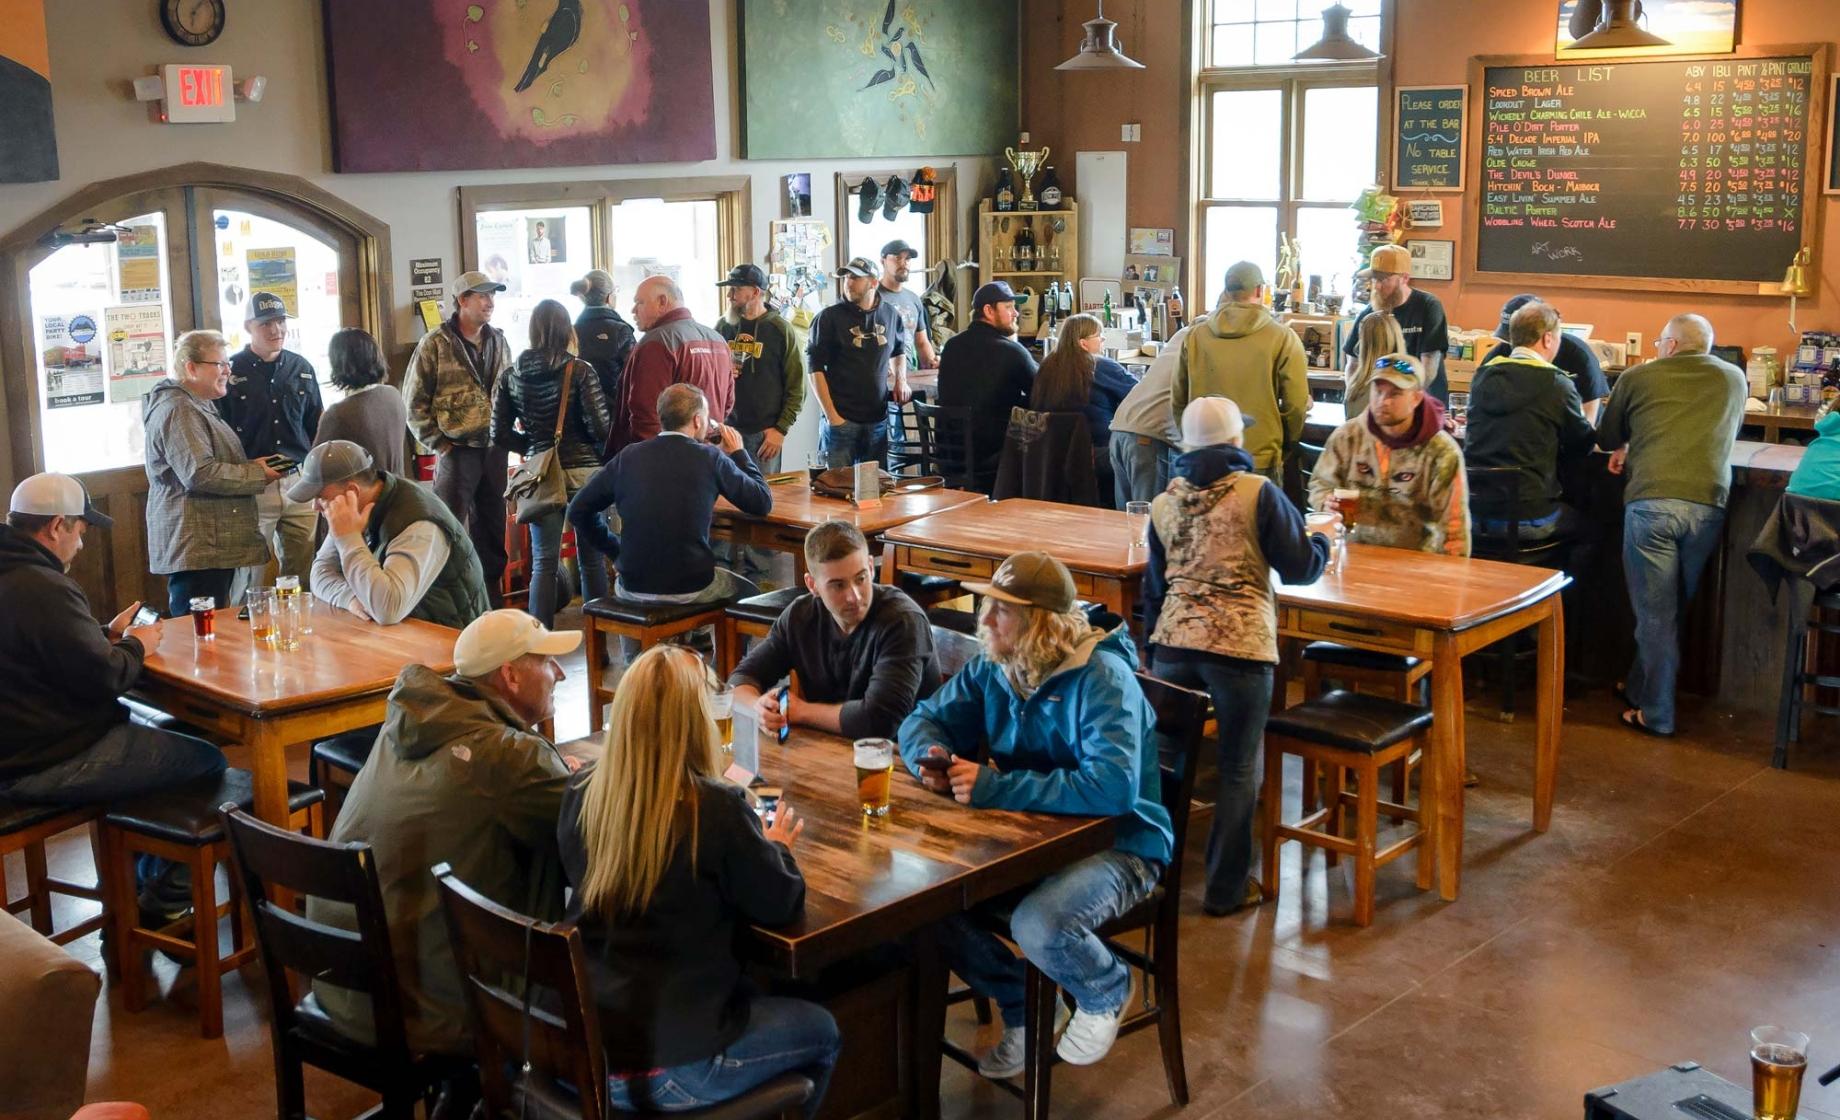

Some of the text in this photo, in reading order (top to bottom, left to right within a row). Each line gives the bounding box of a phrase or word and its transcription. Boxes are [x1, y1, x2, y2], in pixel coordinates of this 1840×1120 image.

[1525, 66, 1615, 83] BEER LIST
[1712, 64, 1731, 77] IBU
[179, 68, 223, 106] EXIT
[1489, 84, 1575, 98] SPICED BROWN ALE
[1713, 81, 1726, 91] 15
[1401, 94, 1433, 110] PLEASE
[1489, 98, 1562, 109] LOOKOUT LAGER
[1711, 94, 1724, 105] 22
[1711, 107, 1724, 117] 15
[1404, 118, 1460, 130] AT THE BAR
[1490, 122, 1510, 132] PILE
[1550, 120, 1580, 131] PORTER
[1682, 119, 1701, 130] 6.0
[1710, 119, 1725, 129] 25
[1487, 131, 1600, 144] 5.4 DECADE IMPERIAL IPA
[1682, 132, 1700, 143] 7.0
[1707, 132, 1726, 143] 100
[1405, 142, 1457, 158] NO TABLE
[1487, 146, 1504, 156] RED
[1505, 146, 1533, 156] WATER
[1559, 145, 1573, 156] RED
[1574, 145, 1590, 156] ALE
[1681, 145, 1699, 155] 6.5
[1710, 144, 1722, 155] 17
[1486, 157, 1507, 168] OLDE
[1680, 157, 1698, 168] 6.3
[1706, 157, 1721, 168] 50
[1410, 164, 1450, 175] SERVICE
[1488, 169, 1505, 180] THE
[1547, 169, 1580, 180] DUNKEL
[1680, 169, 1697, 180] 4.9
[1705, 169, 1722, 180] 20
[1680, 181, 1697, 193] 7.5
[1704, 181, 1721, 193] 20
[1487, 192, 1508, 203] EASY
[1541, 192, 1577, 204] SUMMER
[1579, 193, 1597, 204] ALE
[1703, 194, 1721, 206] 23
[1487, 203, 1558, 216] BALTIC PORTER
[1702, 206, 1720, 218] 50
[1561, 217, 1595, 228] SCOTCH
[1598, 216, 1617, 229] ALE
[1678, 219, 1697, 230] 7.7
[1702, 219, 1720, 231] 30
